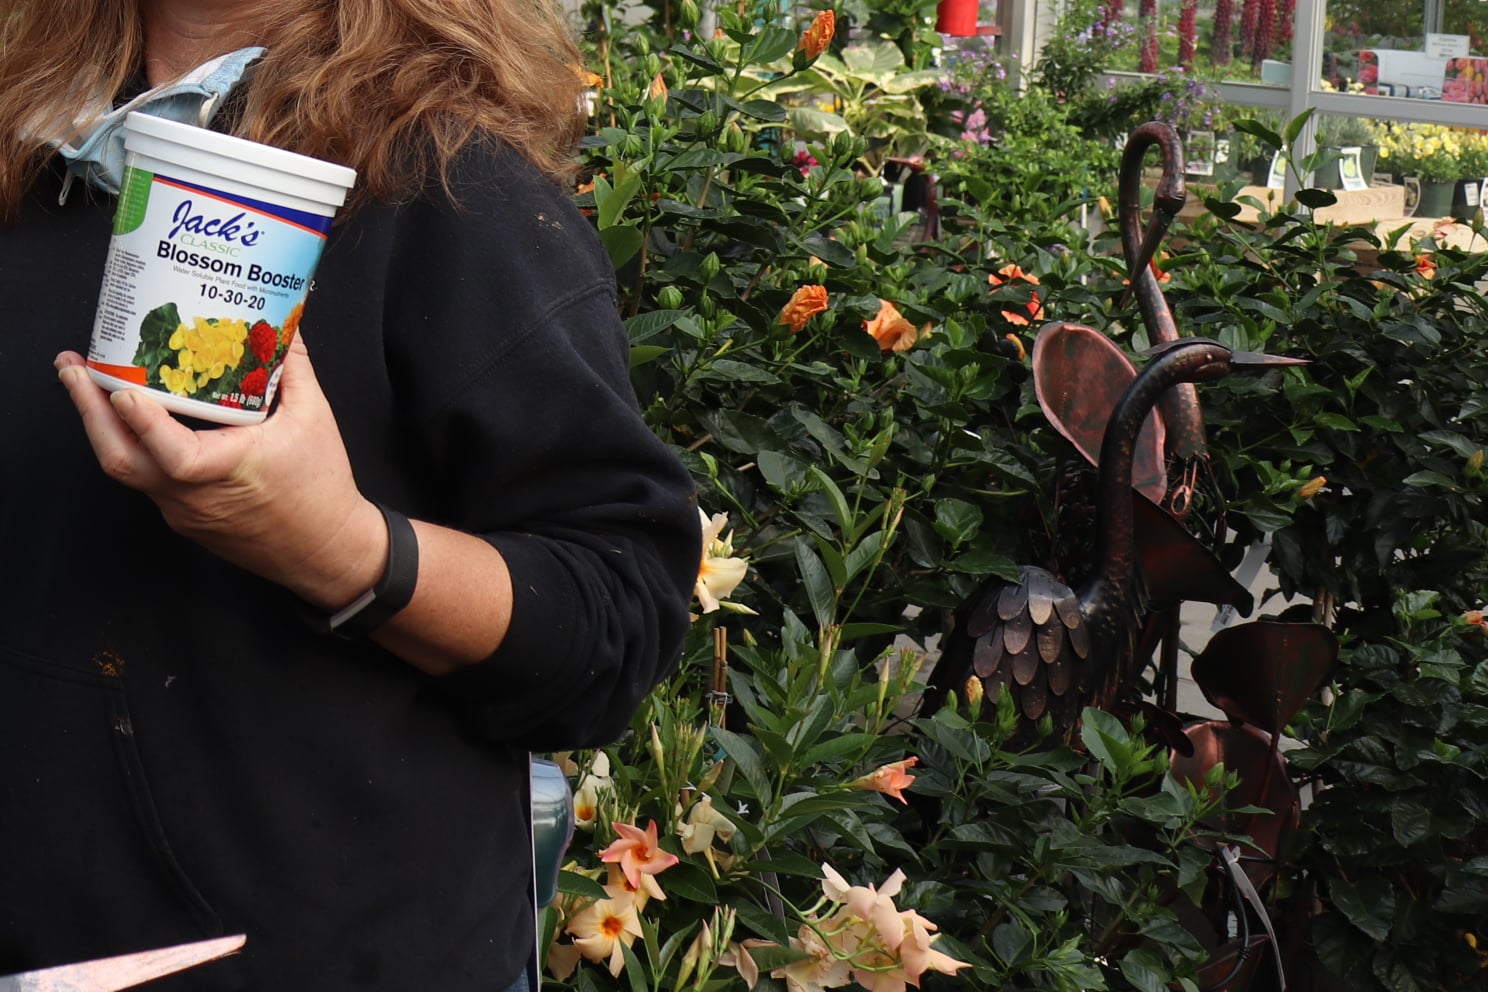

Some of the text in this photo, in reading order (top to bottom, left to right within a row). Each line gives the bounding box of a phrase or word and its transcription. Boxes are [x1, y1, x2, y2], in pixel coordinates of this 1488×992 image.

[168, 200, 260, 247] Jack's
[180, 233, 241, 258] CLASSIC
[157, 240, 305, 291] Blossom Booster
[172, 265, 190, 275] Water
[191, 270, 214, 281] Soluble
[215, 276, 231, 285] Plant
[231, 280, 246, 289] Food
[200, 283, 266, 311] 10-30-20
